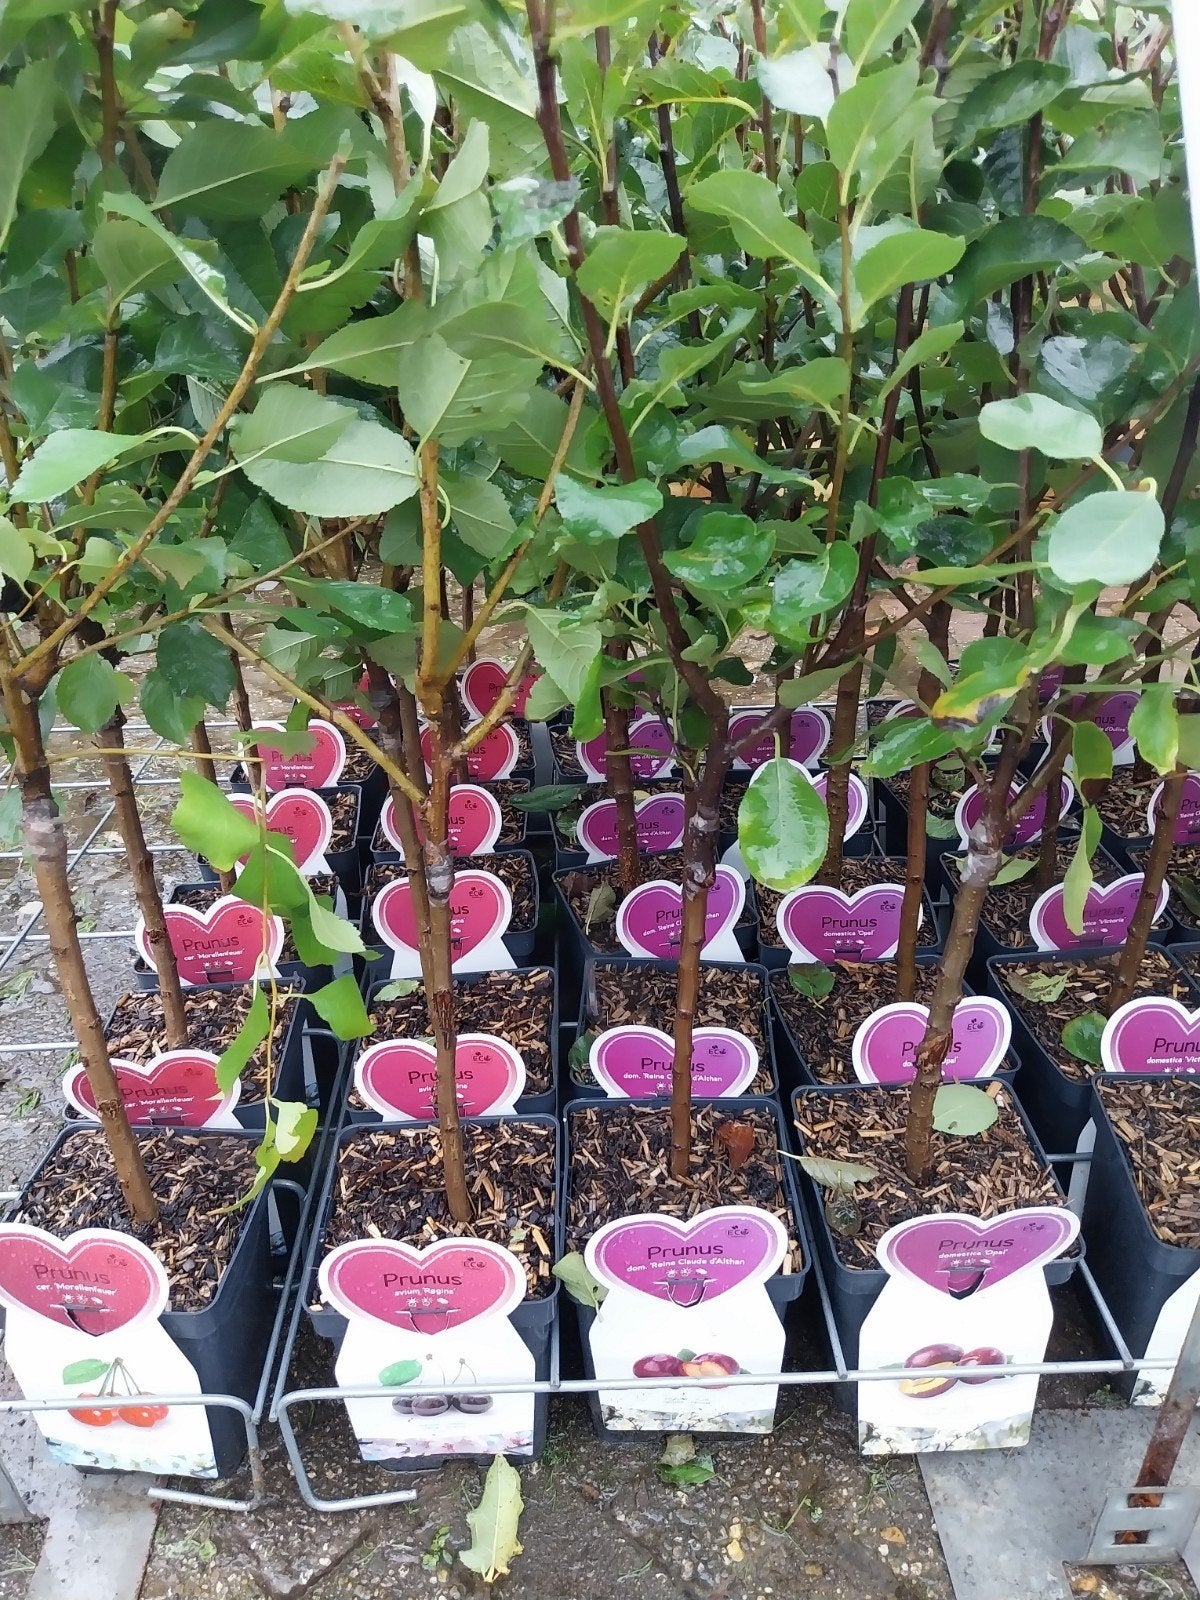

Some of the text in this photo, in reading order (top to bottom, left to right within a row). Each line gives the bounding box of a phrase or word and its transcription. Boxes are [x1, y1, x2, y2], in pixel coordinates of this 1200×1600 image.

[469, 889, 484, 897] ECO
[880, 903, 896, 911] ECO
[237, 917, 254, 926] ECO
[821, 915, 878, 929] Prunus
[823, 930, 857, 938] domestica
[182, 935, 240, 951] Prunus
[967, 1022, 984, 1031] ECO
[708, 1047, 727, 1055] ECO
[472, 1054, 492, 1063] ECO
[1146, 1056, 1183, 1065] domestica
[623, 1072, 641, 1080] dom.
[121, 1084, 189, 1099] Prunus
[727, 1228, 750, 1237] ECO
[938, 1238, 1015, 1251] Prunus
[647, 1244, 724, 1260] Prunus
[463, 1259, 487, 1269] ECO
[626, 1257, 745, 1273] dom. 'Reine Claude d'Althan
[33, 1263, 111, 1285] Prunus
[383, 1272, 463, 1287] Prunus
[35, 1281, 118, 1297] cer. 'Morellenfeuer'
[394, 1288, 420, 1297] avium
